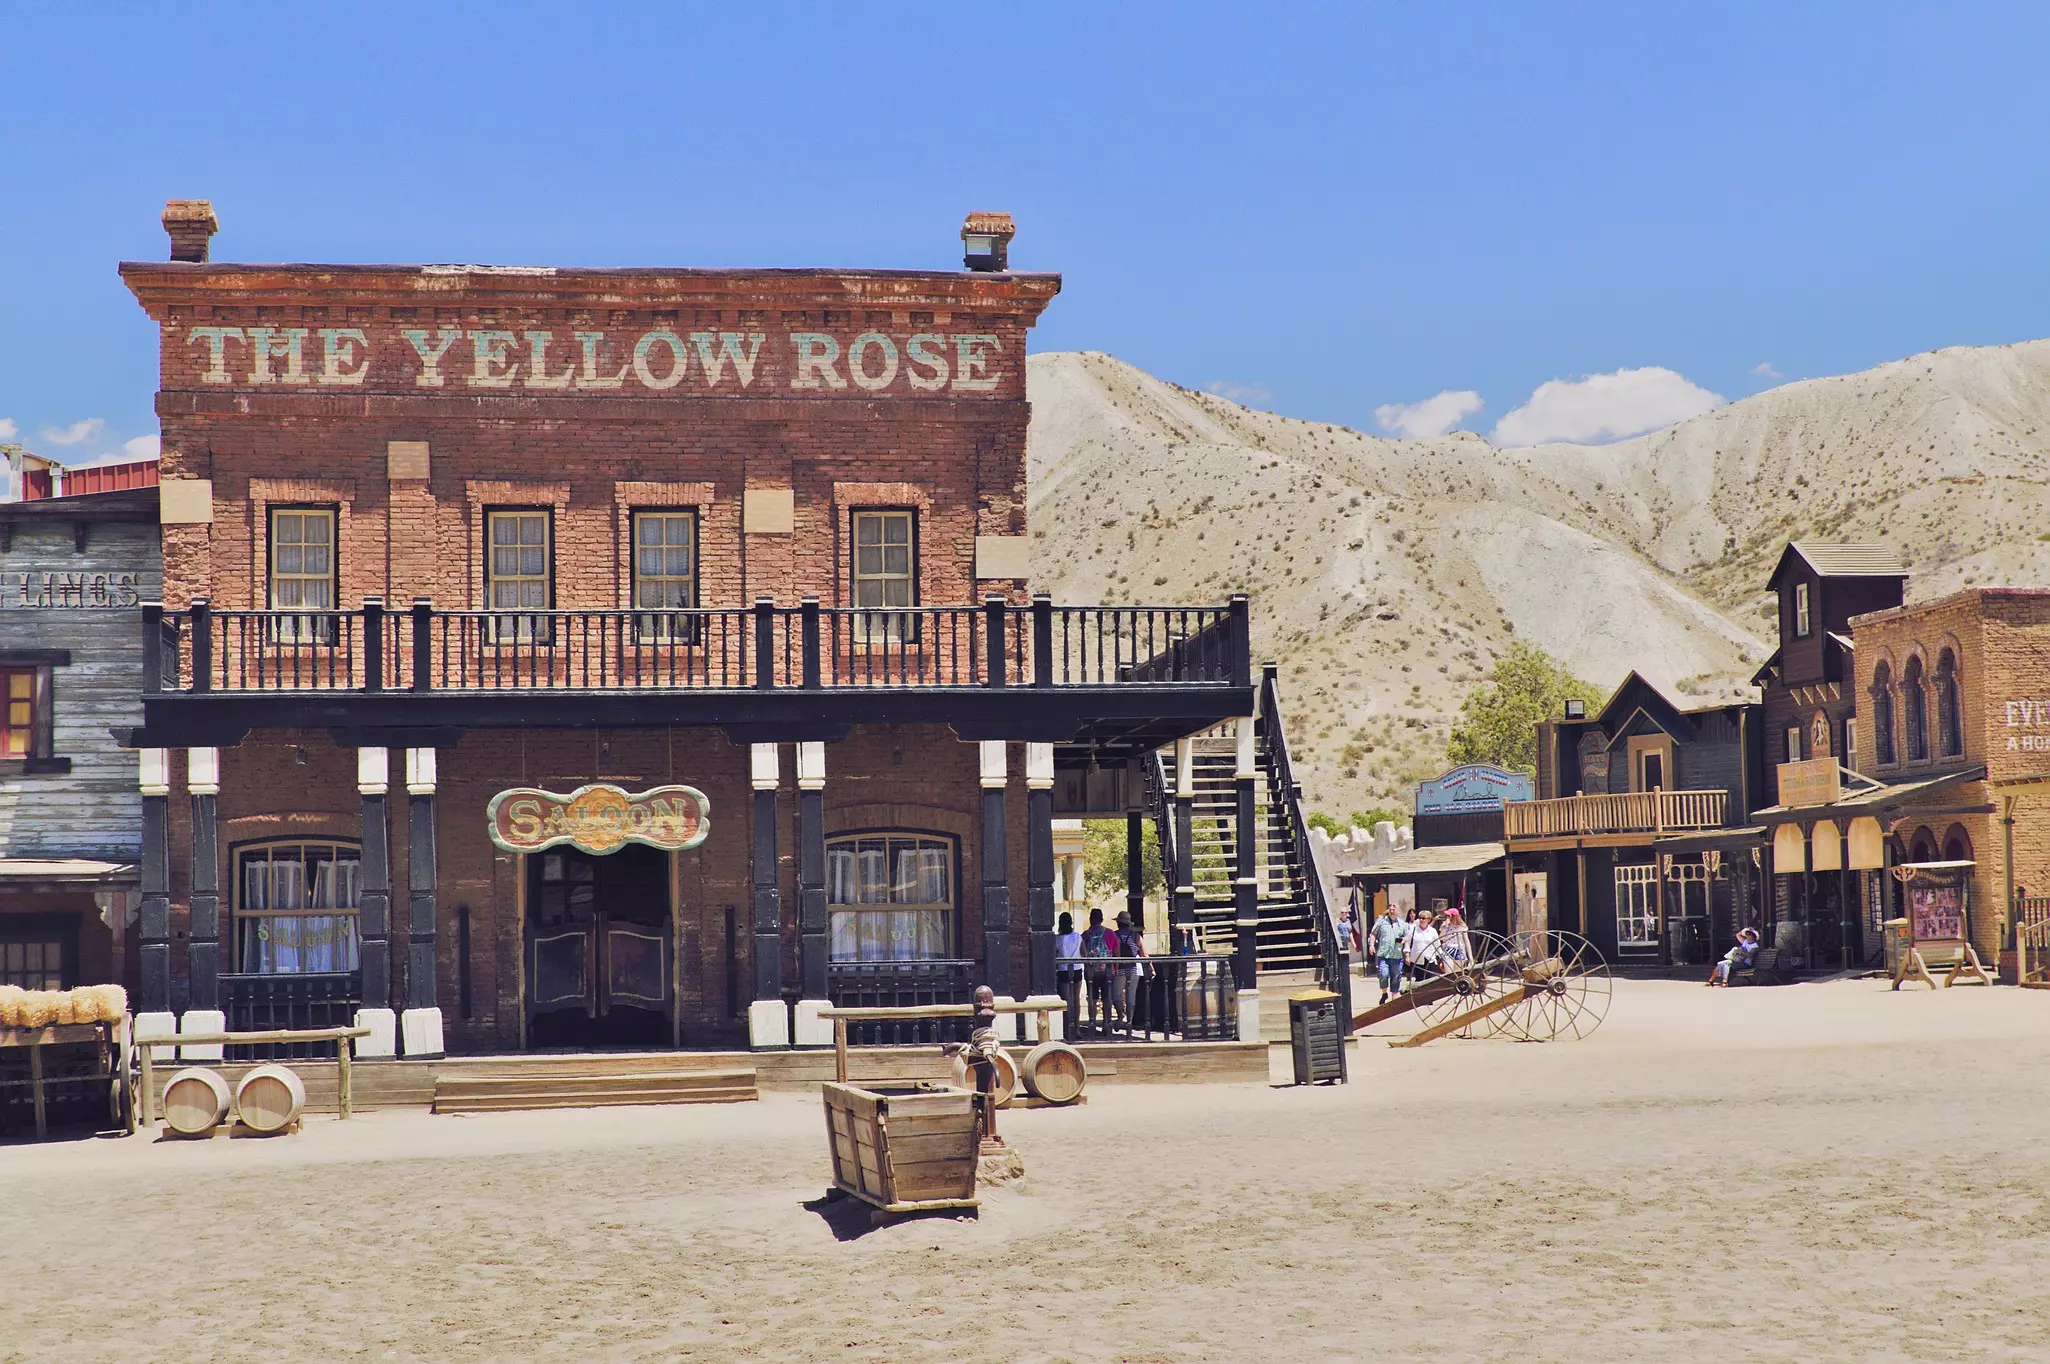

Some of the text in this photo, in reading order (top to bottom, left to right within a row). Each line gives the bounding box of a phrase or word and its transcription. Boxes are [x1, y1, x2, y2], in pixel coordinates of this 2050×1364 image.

[187, 327, 1002, 391] THE YELLOW ROSE
[19, 572, 139, 608] LINES
[2005, 737, 2019, 751] A
[508, 797, 687, 840] SALOON
